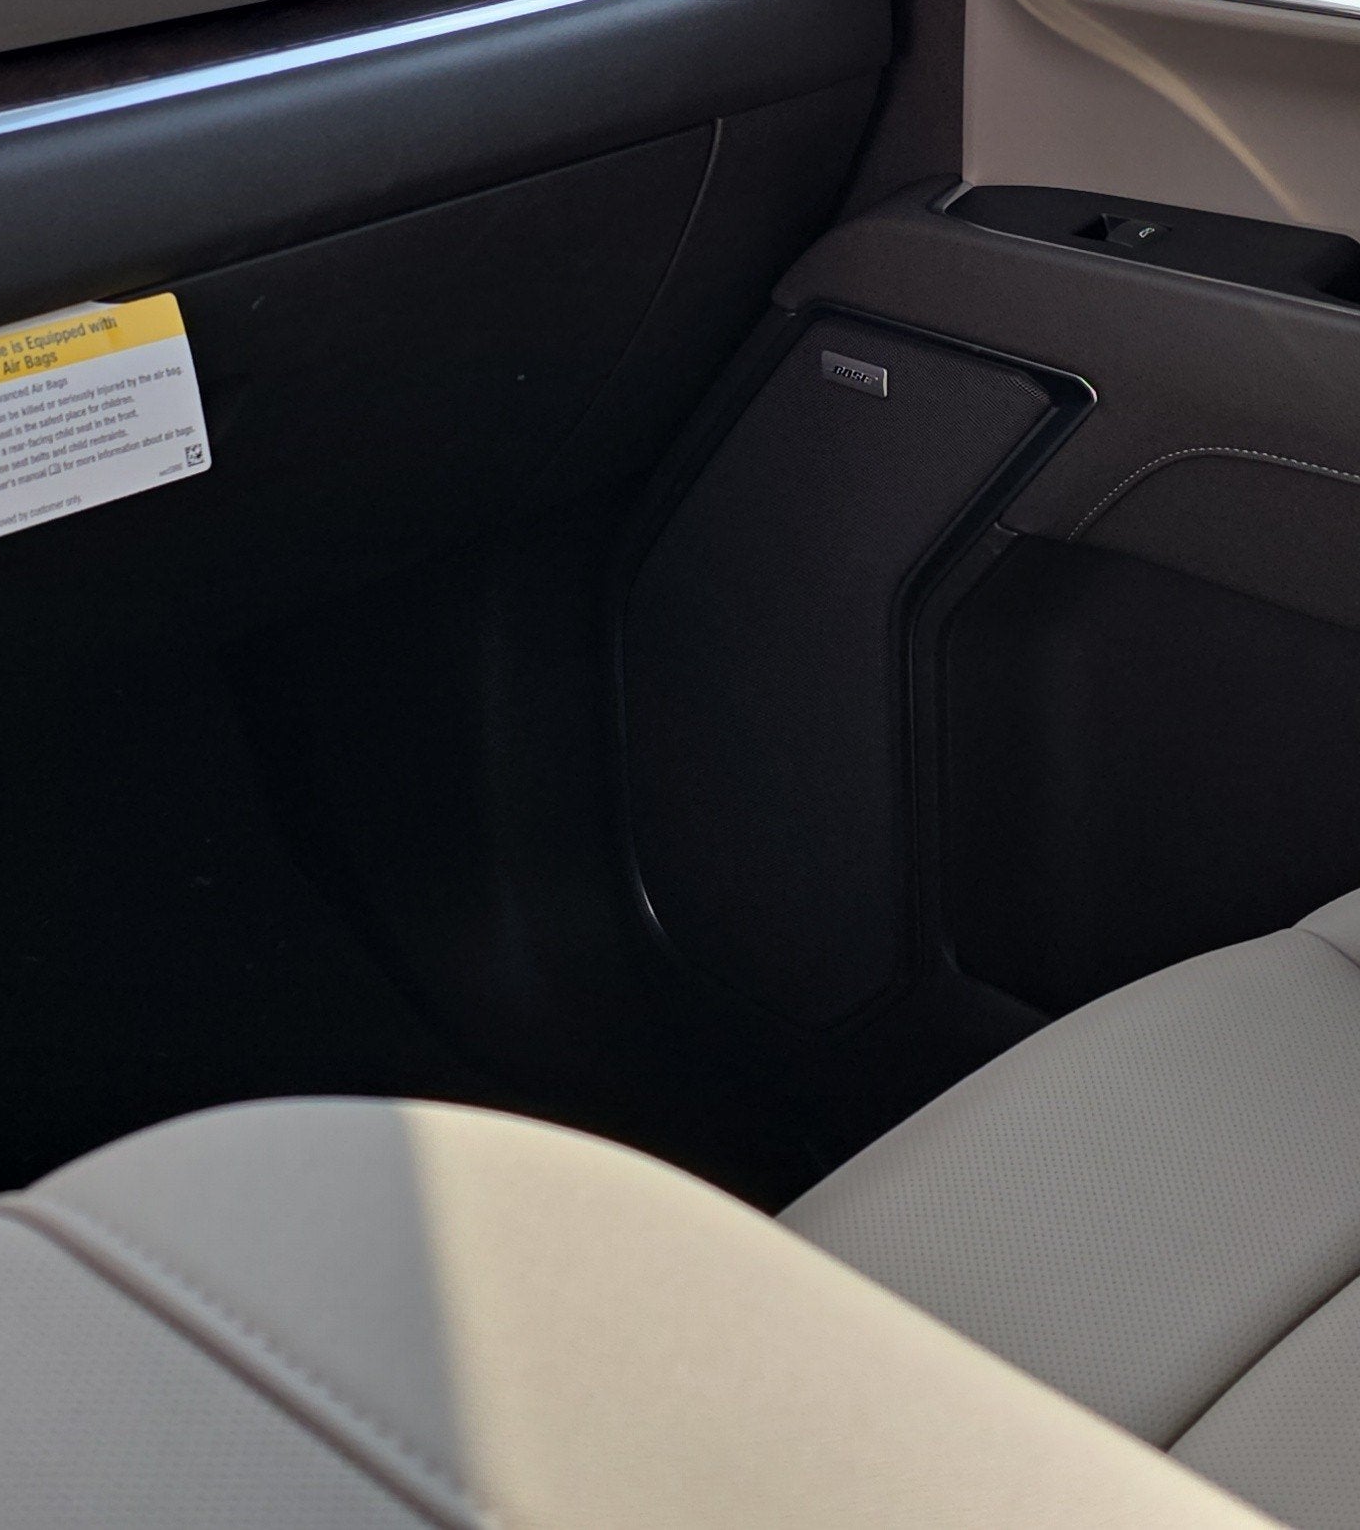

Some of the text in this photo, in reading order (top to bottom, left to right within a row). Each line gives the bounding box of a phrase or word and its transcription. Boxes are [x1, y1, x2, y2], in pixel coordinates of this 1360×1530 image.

[10, 341, 23, 354] is
[25, 322, 86, 350] Equipped
[89, 316, 117, 333] with
[3, 359, 20, 375] Air
[24, 352, 57, 369] Bags
[8, 411, 19, 420] be
[22, 402, 45, 416] killed
[58, 390, 95, 407] seriously
[97, 380, 125, 395] injured
[139, 374, 151, 384] the
[154, 370, 164, 380] air
[32, 383, 43, 394] Air
[45, 378, 68, 391] Bags
[24, 422, 37, 432] the
[65, 408, 87, 423] place
[55, 427, 74, 440] child
[76, 422, 93, 434] seat
[104, 416, 116, 425] the
[12, 457, 28, 470] seat
[30, 451, 51, 464] belts
[52, 445, 67, 458] and
[69, 439, 88, 453] child
[18, 469, 47, 485] manual
[30, 500, 63, 518] customer
